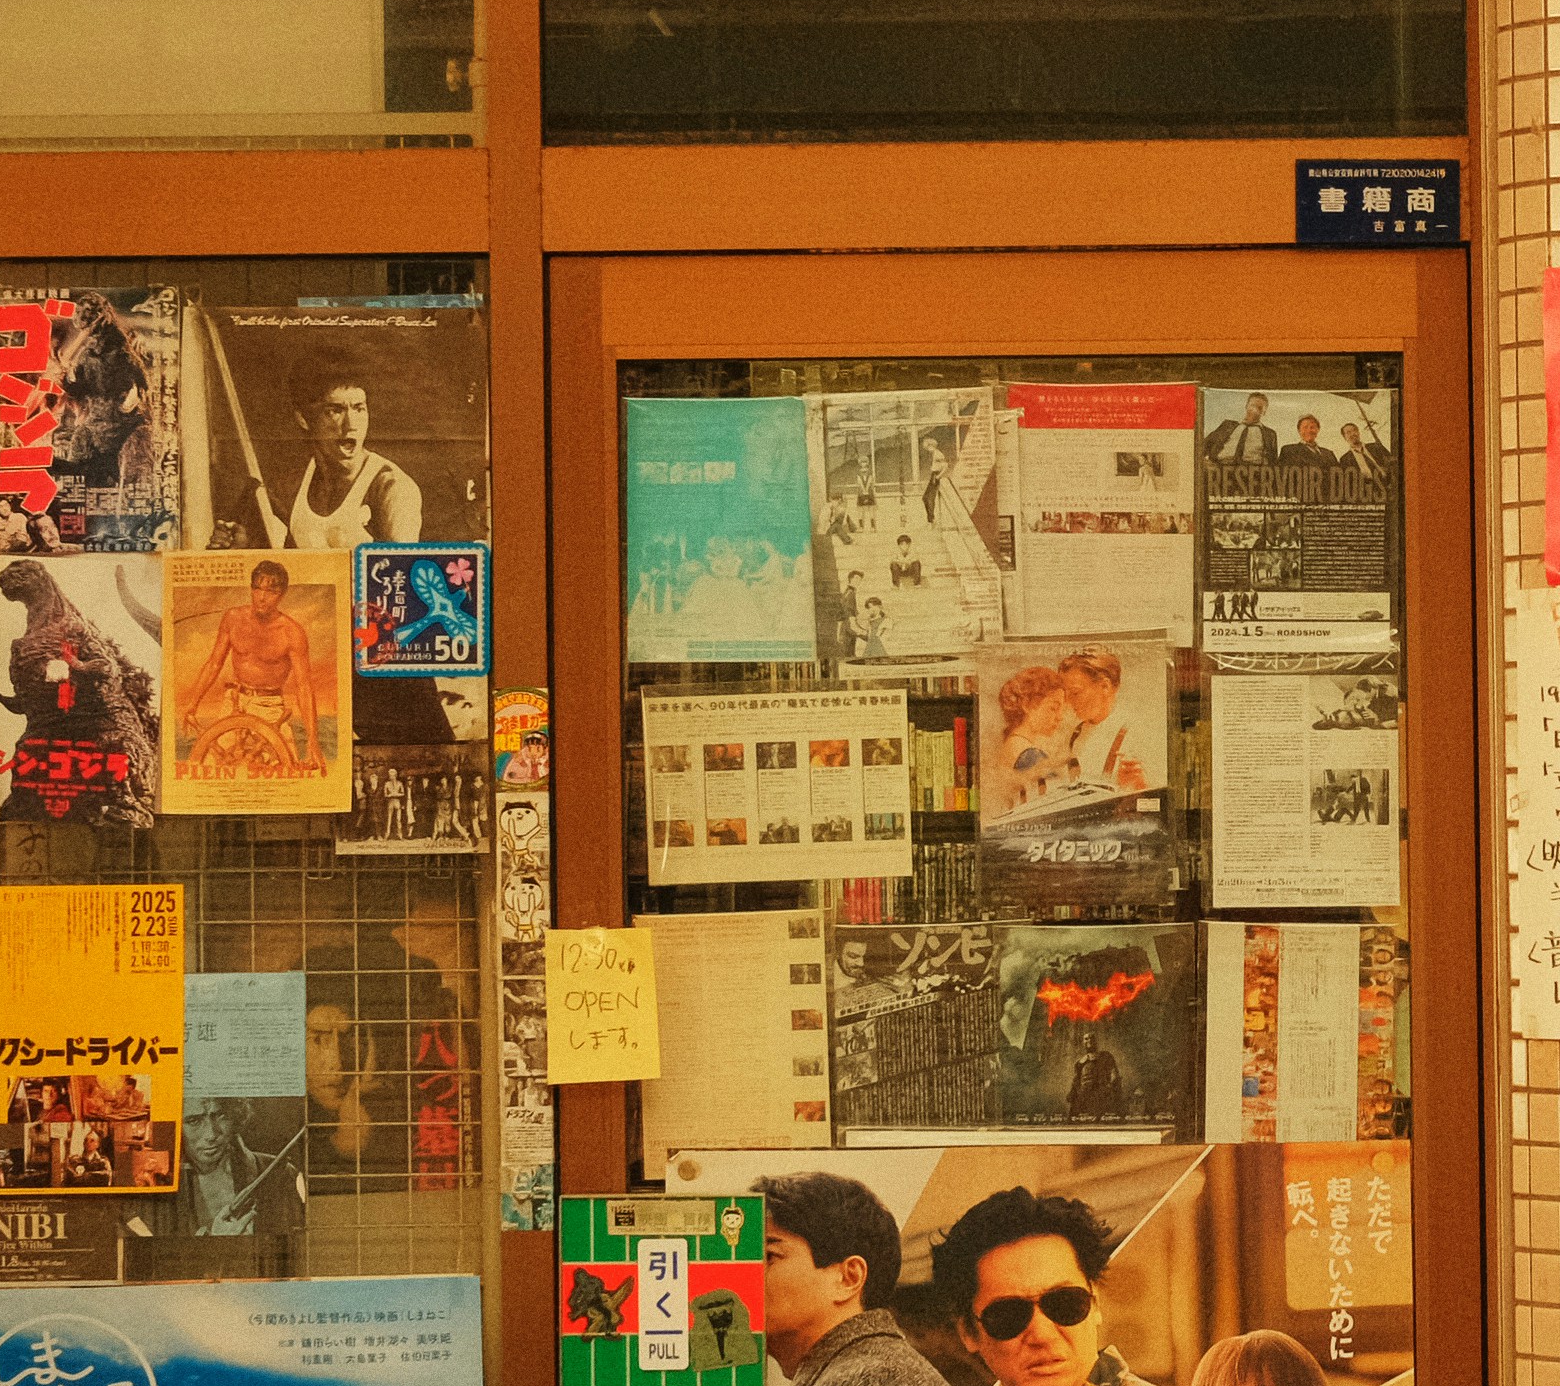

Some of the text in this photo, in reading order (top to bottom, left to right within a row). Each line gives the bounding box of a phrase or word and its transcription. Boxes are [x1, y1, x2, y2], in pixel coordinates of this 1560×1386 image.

[1318, 187, 1436, 213] 書籍商
[1207, 466, 1325, 502] RESERVOIR
[1330, 465, 1387, 503] DOGS
[435, 635, 469, 661] 50
[1028, 841, 1122, 862] タイタニック
[131, 891, 176, 913] 2025
[131, 916, 178, 937] 2.23 SUN
[890, 926, 995, 973] ゾンビ
[564, 986, 640, 1015] OPEN
[569, 1024, 639, 1050] します。
[1366, 1175, 1393, 1254] ただで
[20, 1242, 53, 1250] Within
[1326, 1178, 1357, 1360] 起きないために
[647, 1251, 681, 1319] 引く
[648, 1344, 680, 1360] PULL
